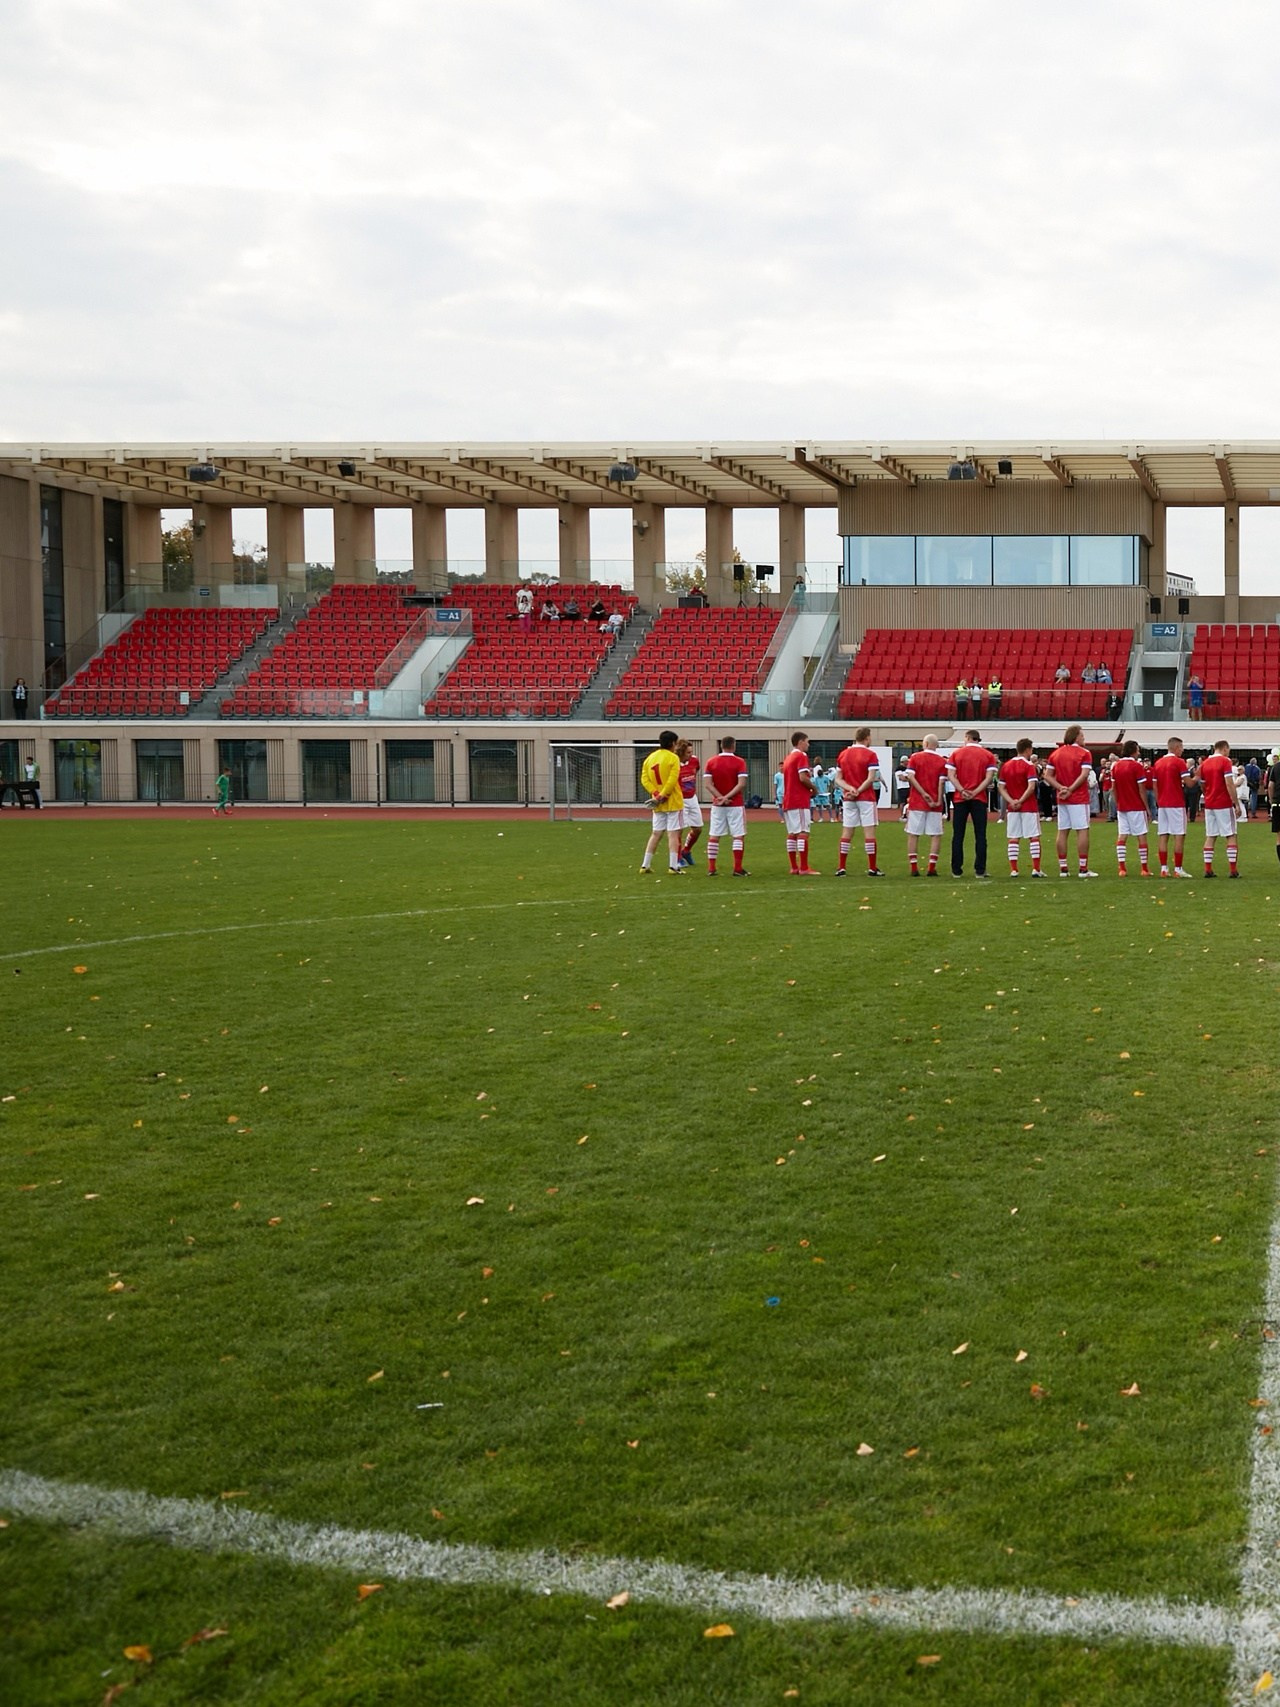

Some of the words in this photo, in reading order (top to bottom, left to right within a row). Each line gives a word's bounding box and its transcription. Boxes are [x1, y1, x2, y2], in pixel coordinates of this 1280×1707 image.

[448, 612, 460, 620] A1
[1164, 626, 1175, 634] A2
[651, 763, 663, 785] 1
